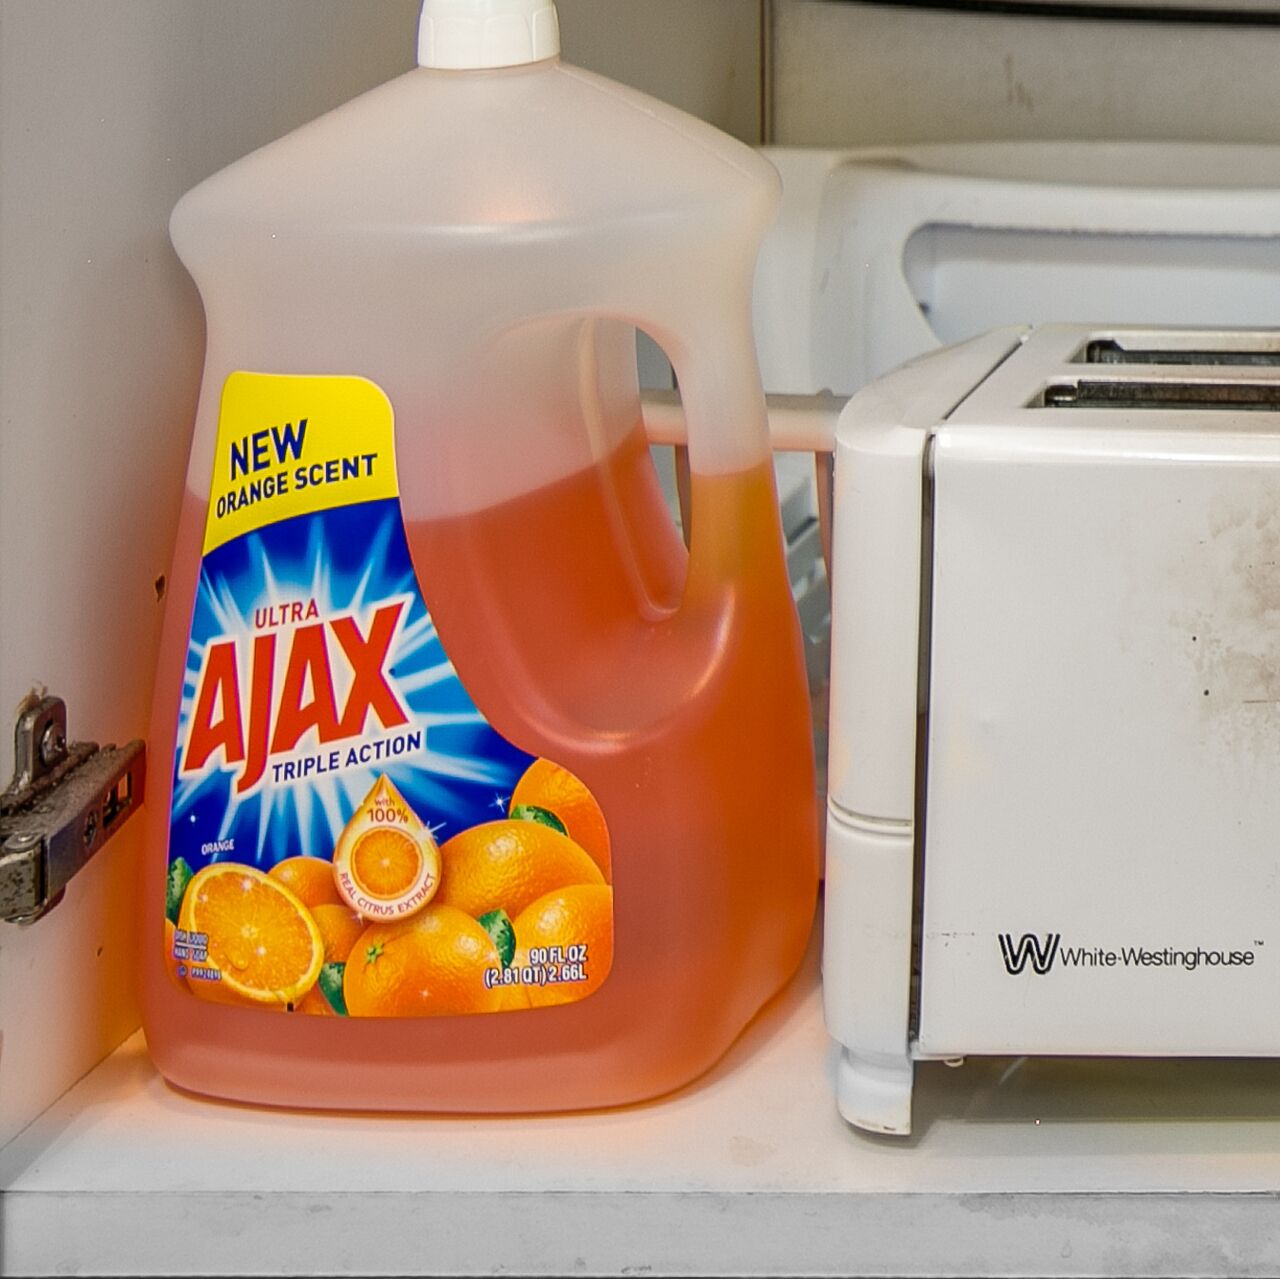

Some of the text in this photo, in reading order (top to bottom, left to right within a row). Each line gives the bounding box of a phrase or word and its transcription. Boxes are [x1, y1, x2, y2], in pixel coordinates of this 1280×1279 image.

[230, 419, 308, 481] NEW
[216, 453, 378, 519] ORANGE SCENT
[255, 598, 319, 629] ULTRA
[183, 600, 410, 790] AJAX
[272, 731, 422, 783] TRIPLE ACTION
[367, 808, 409, 823] 100%
[375, 797, 395, 806] with
[201, 838, 235, 856] ORANGE
[340, 872, 435, 915] REAL CITRUS EXTRACT
[530, 945, 588, 964] 90 FL OZ
[485, 964, 588, 988] (2.81 QT) 2.66L
